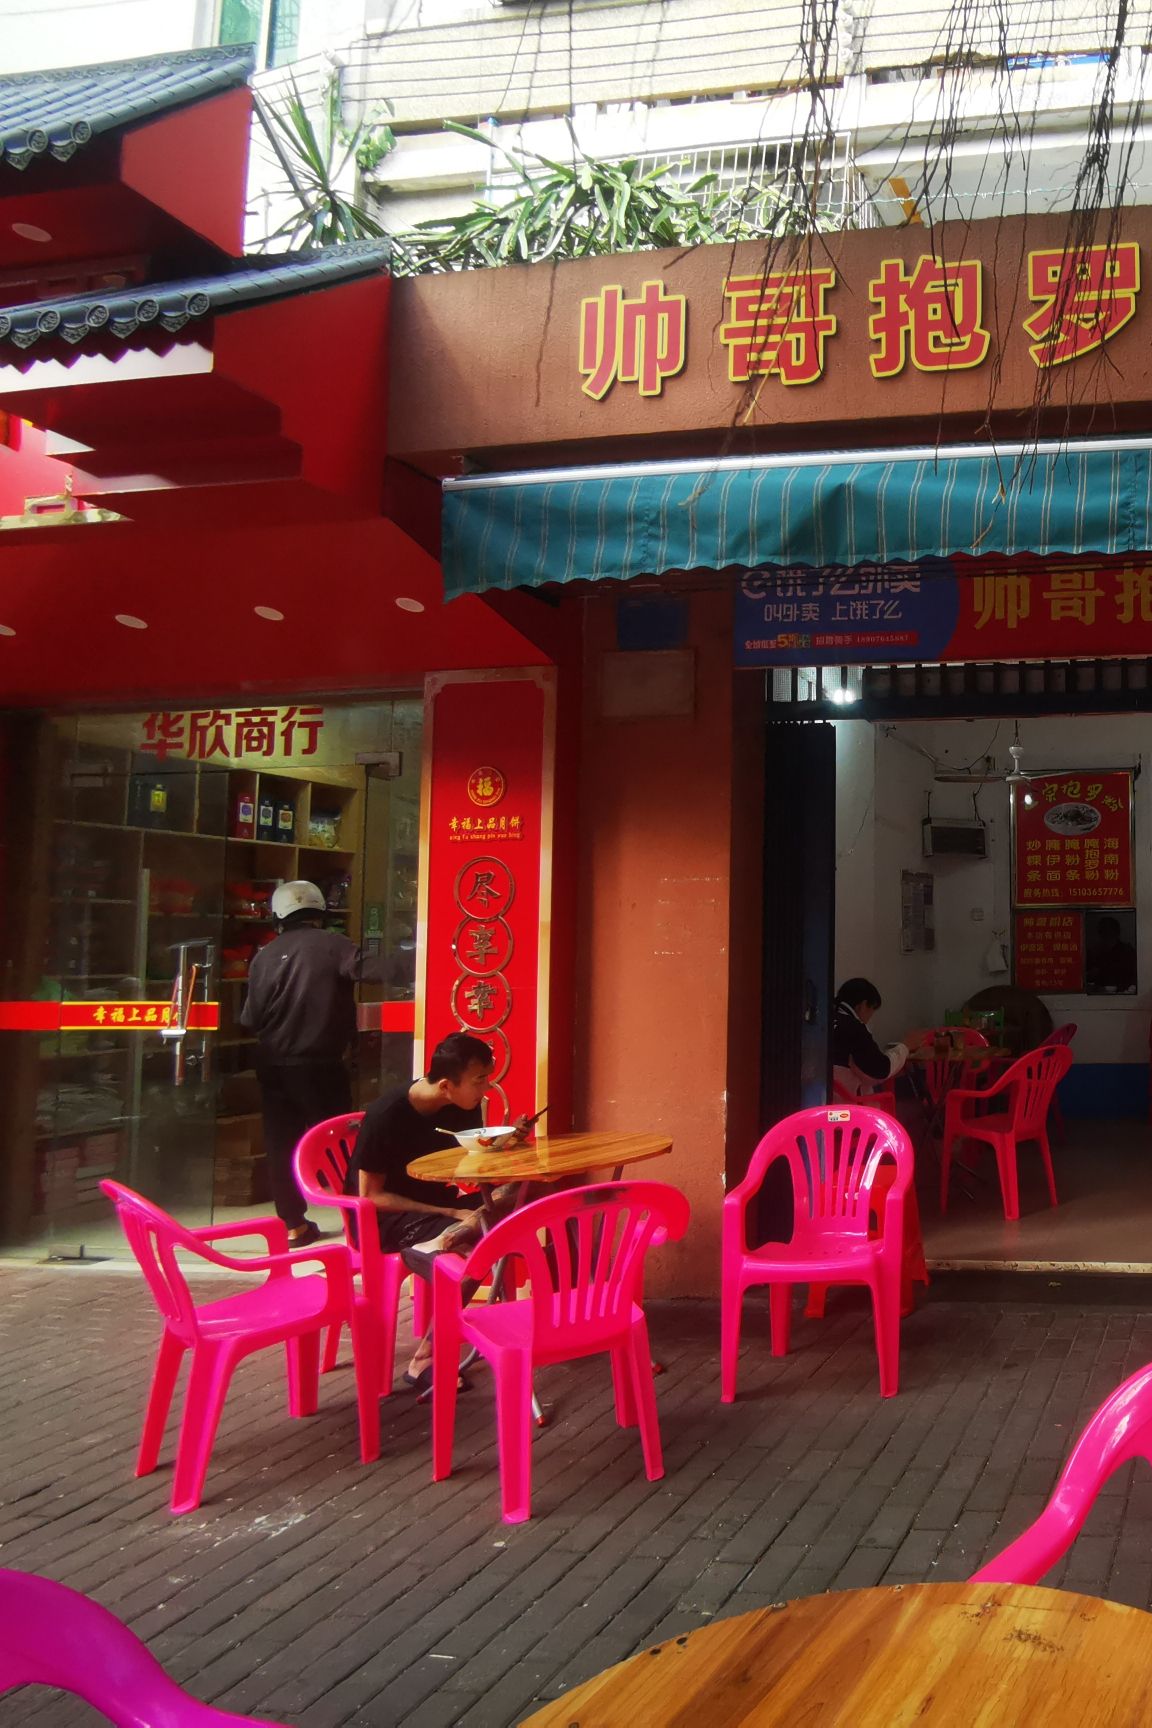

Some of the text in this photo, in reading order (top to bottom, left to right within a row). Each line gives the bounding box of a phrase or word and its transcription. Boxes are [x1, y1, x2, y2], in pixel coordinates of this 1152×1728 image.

[140, 706, 324, 762] 华欣商行
[449, 816, 520, 832] 幸福上品月饼
